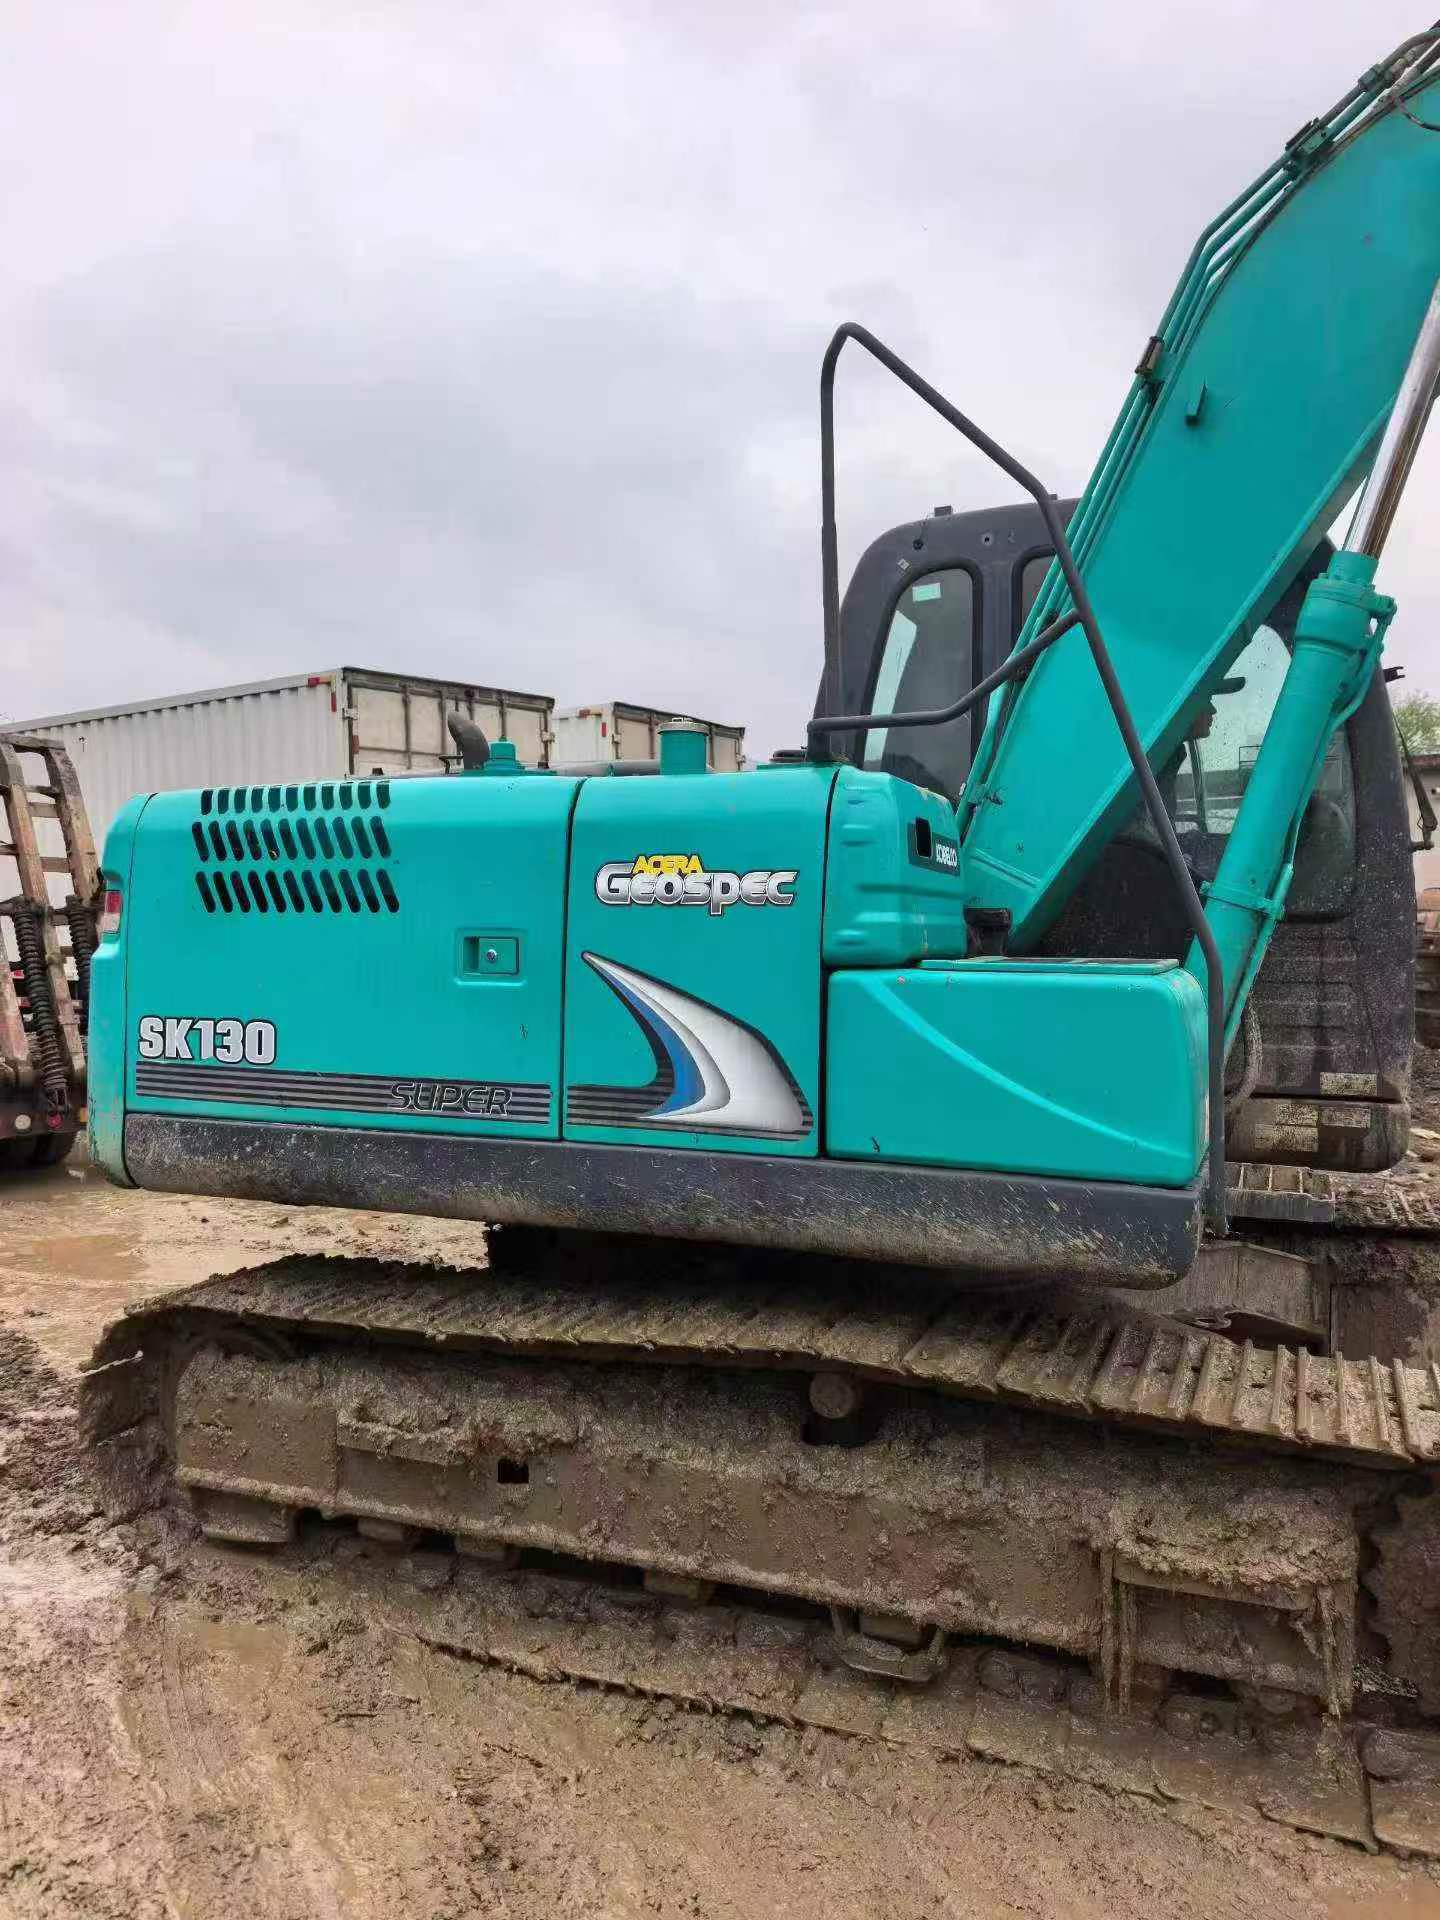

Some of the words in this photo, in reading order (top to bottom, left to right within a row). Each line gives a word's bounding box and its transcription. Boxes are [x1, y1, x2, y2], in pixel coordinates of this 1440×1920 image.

[631, 854, 704, 876] ACERA
[137, 1015, 276, 1066] SK130
[390, 1080, 513, 1117] SUPER
